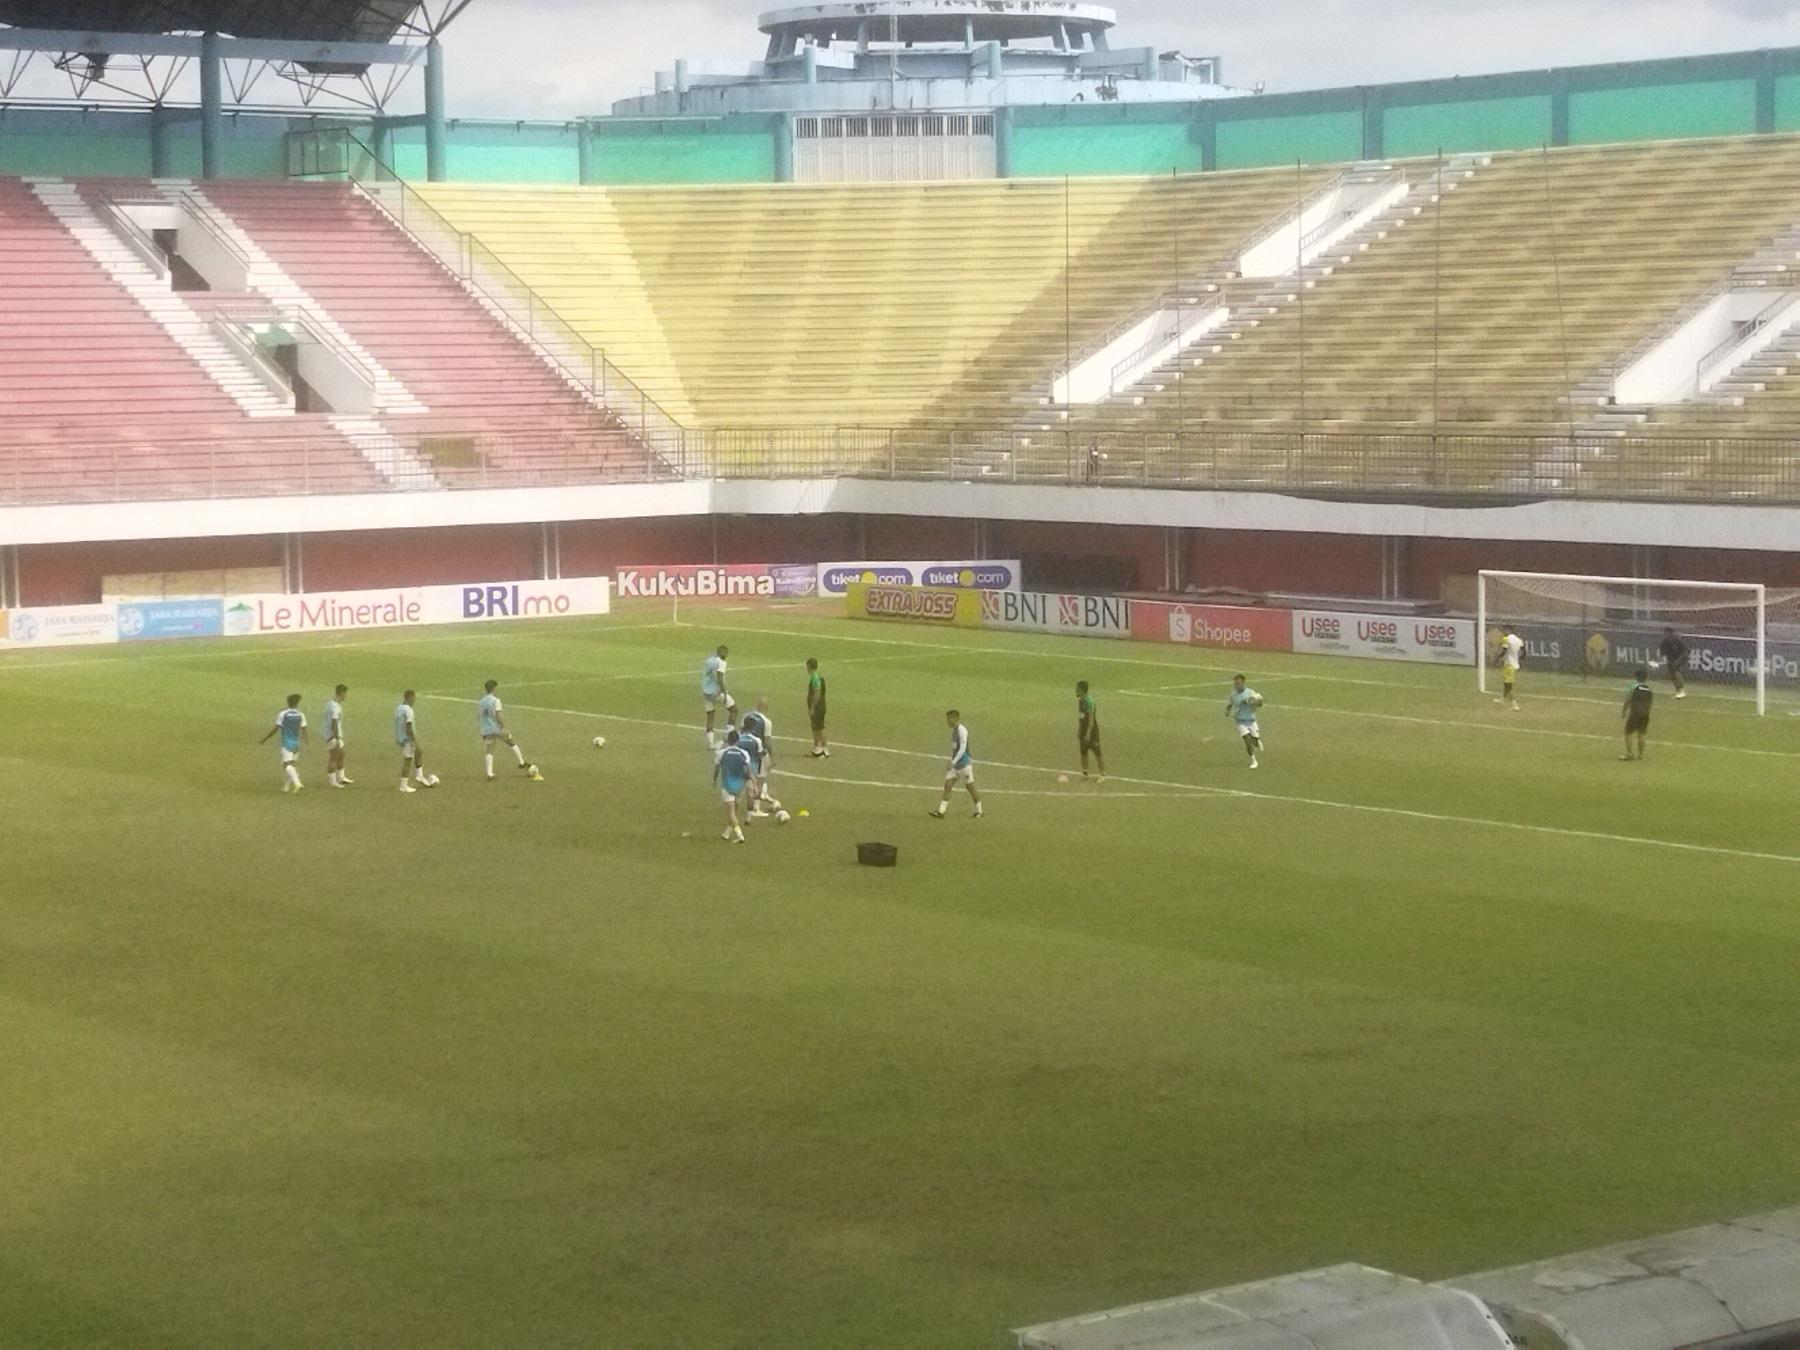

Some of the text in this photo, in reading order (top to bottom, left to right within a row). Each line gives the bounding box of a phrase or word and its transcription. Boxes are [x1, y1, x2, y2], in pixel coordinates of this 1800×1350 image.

[616, 569, 776, 597] KukuBima
[258, 594, 421, 631] Le Minerale
[867, 589, 956, 617] EXTRA JOSS
[1004, 591, 1048, 625] BNI
[1084, 596, 1130, 631] BNI
[1194, 618, 1252, 647] Shopee
[1302, 616, 1340, 638] Usee
[1357, 620, 1397, 641] Usee
[1415, 624, 1456, 646] Usee
[1524, 640, 1560, 658] ILLS
